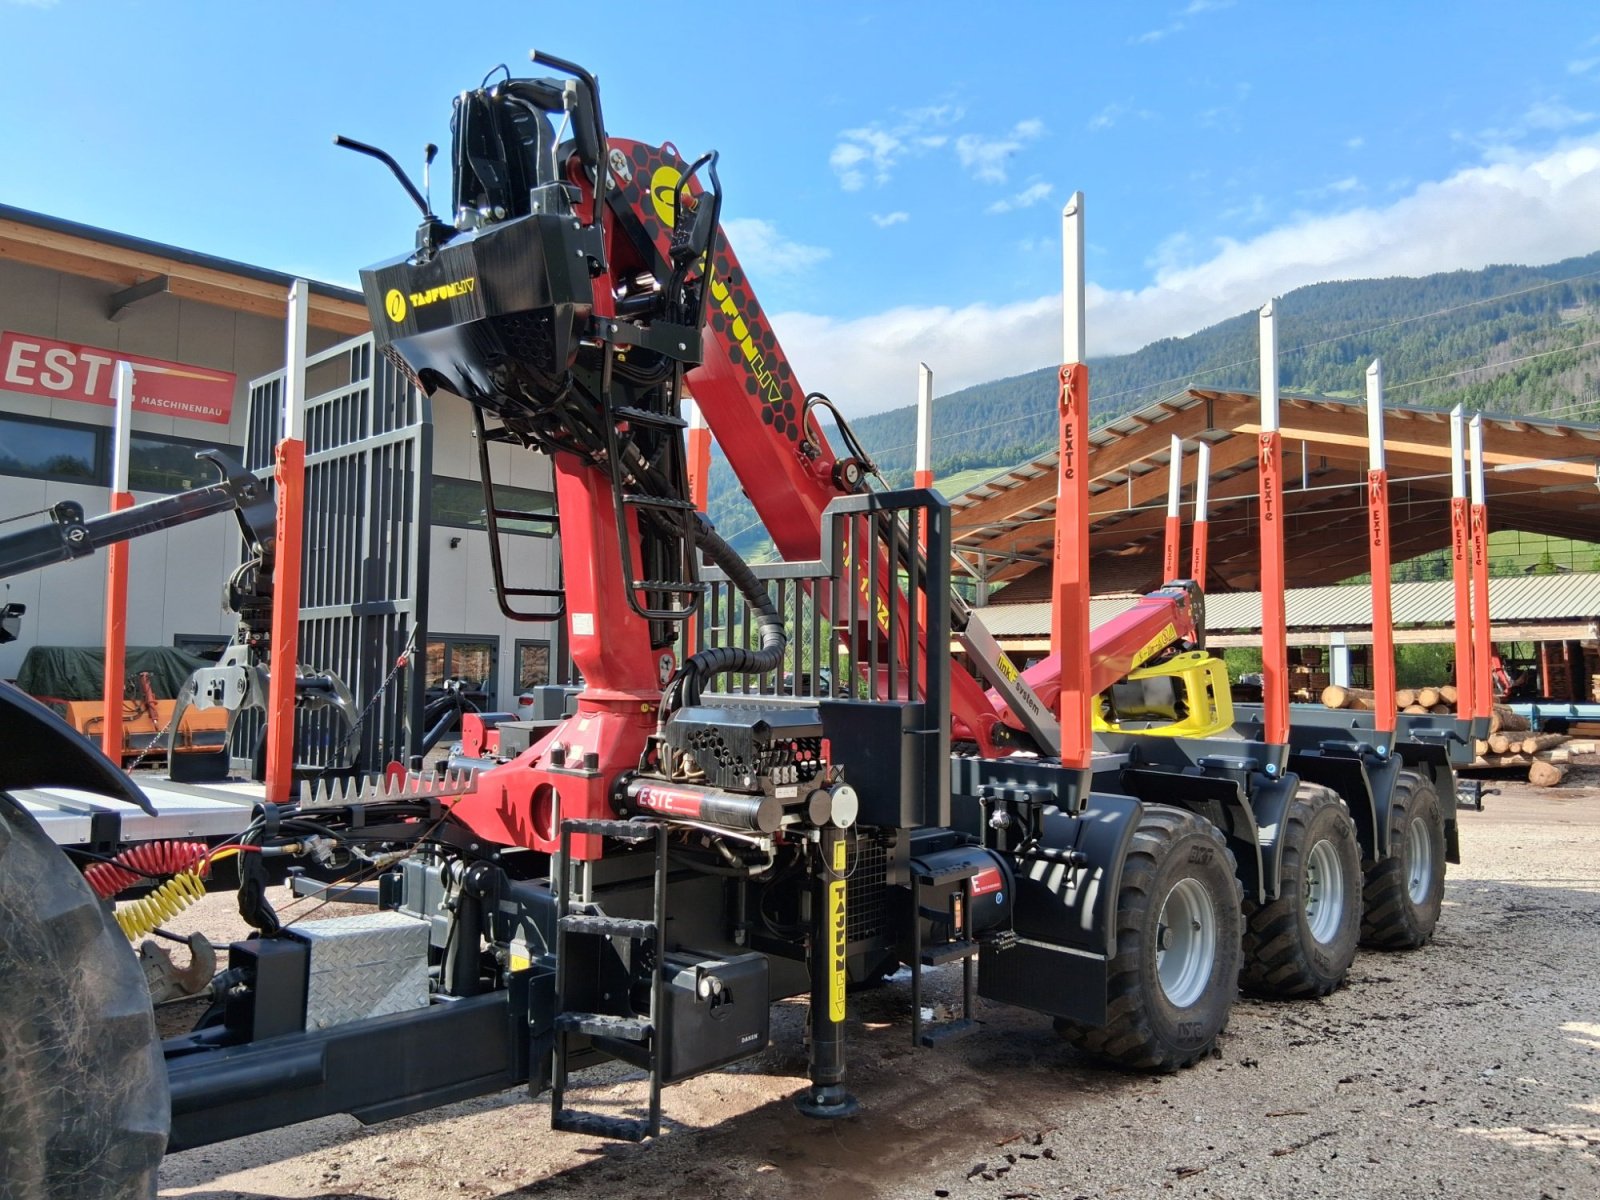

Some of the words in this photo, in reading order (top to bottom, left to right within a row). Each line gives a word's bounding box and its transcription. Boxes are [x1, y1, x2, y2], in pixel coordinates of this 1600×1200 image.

[140, 396, 223, 417] MASCHINENBAU
[1015, 682, 1040, 716] system
[639, 788, 674, 810] ESTE
